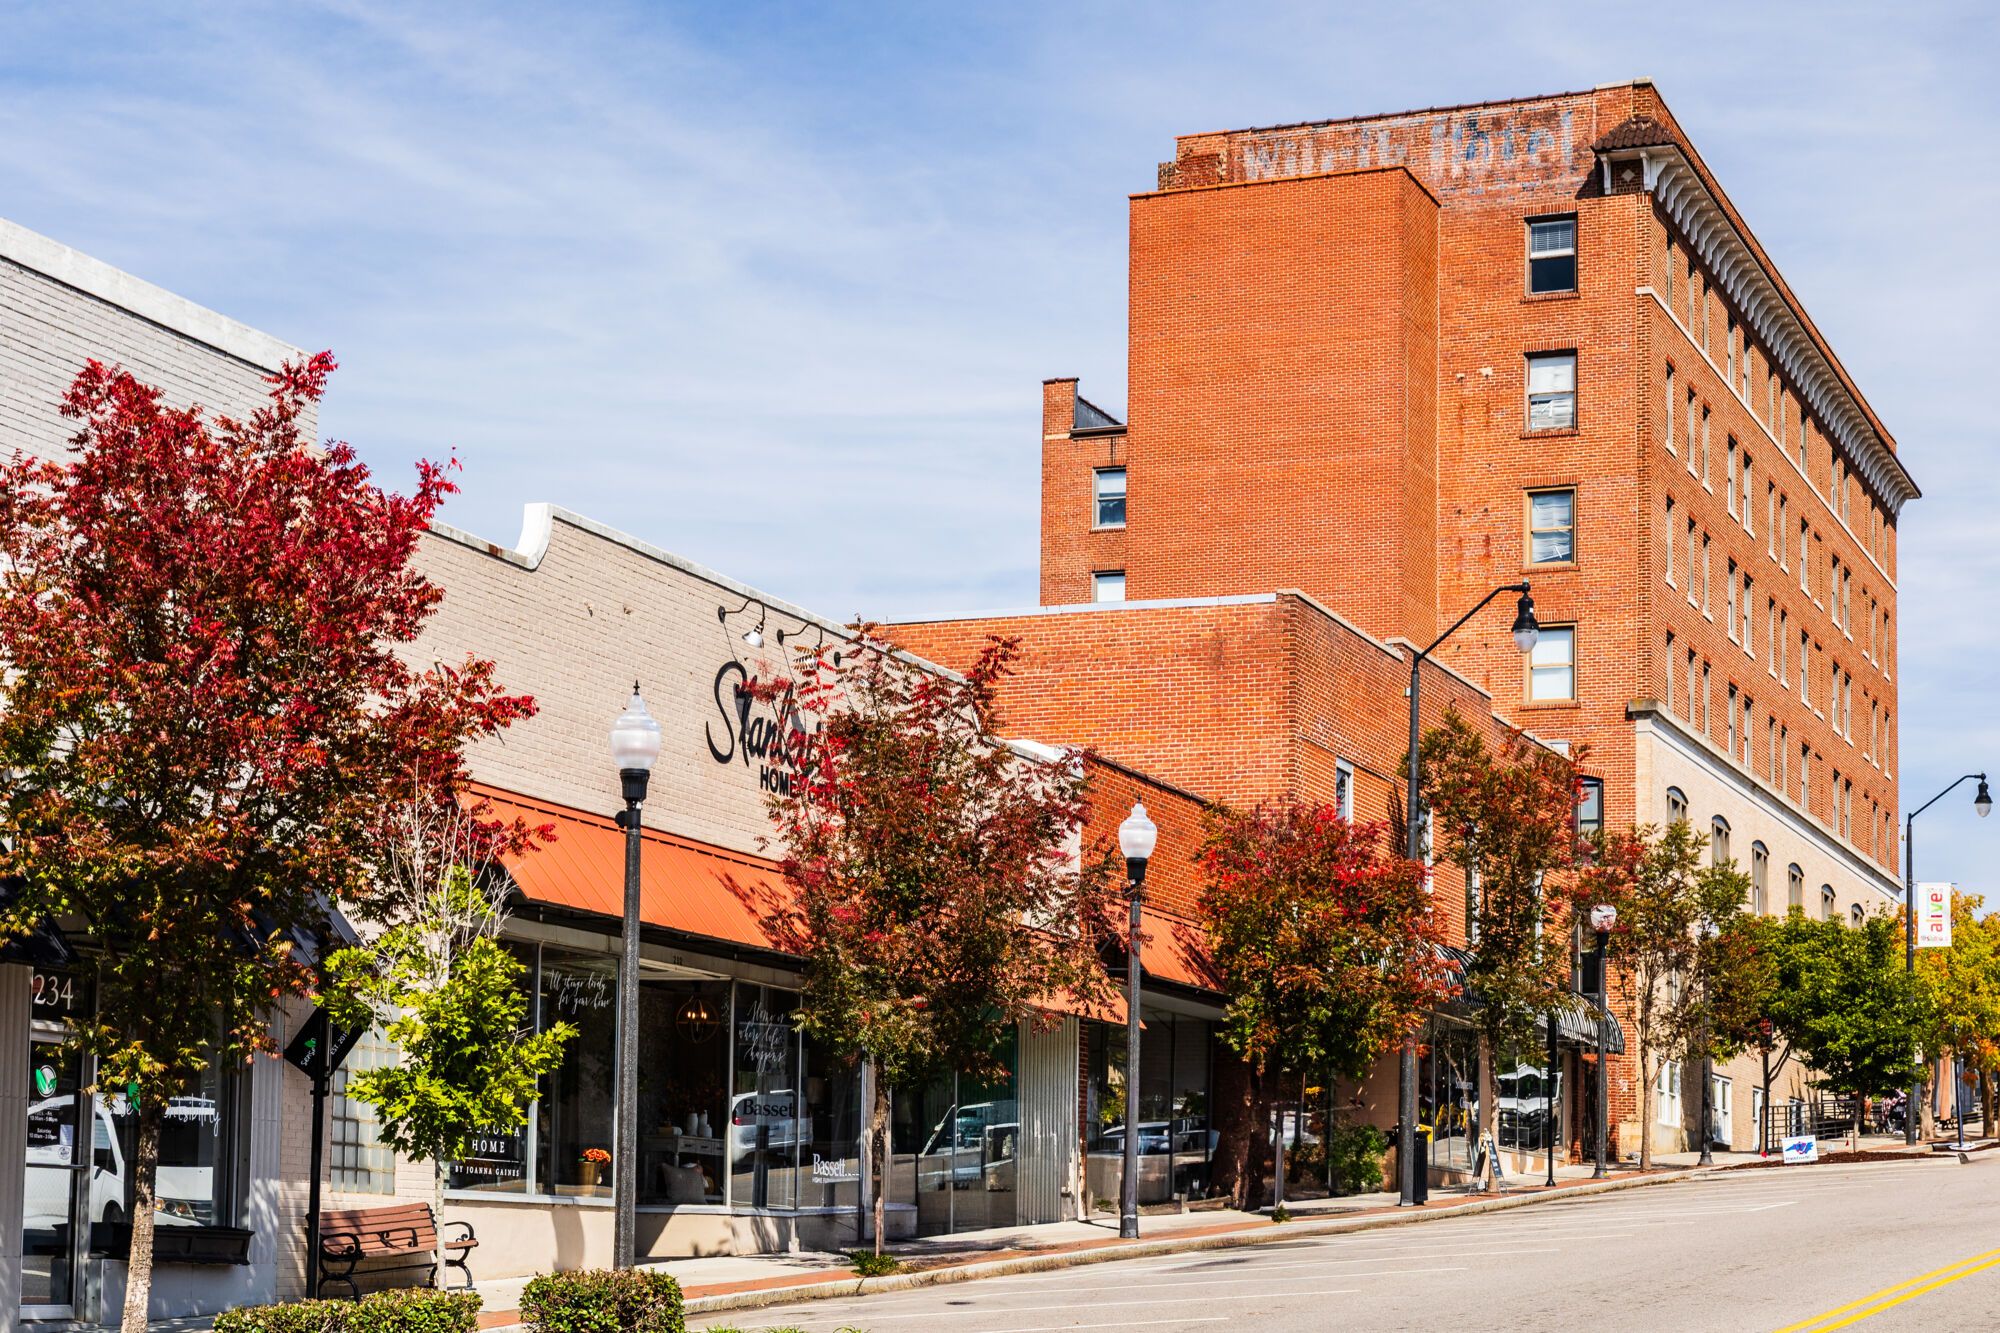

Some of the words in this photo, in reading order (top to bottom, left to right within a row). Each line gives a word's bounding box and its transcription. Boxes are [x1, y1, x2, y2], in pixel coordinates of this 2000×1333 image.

[1926, 893, 1943, 932] alive
[33, 974, 74, 1010] 234
[472, 1139, 505, 1153] HOME
[455, 1165, 463, 1173] BY
[466, 1166, 493, 1175] JOANNA
[495, 1168, 520, 1177] GAINES
[812, 1153, 846, 1177] Bassett
